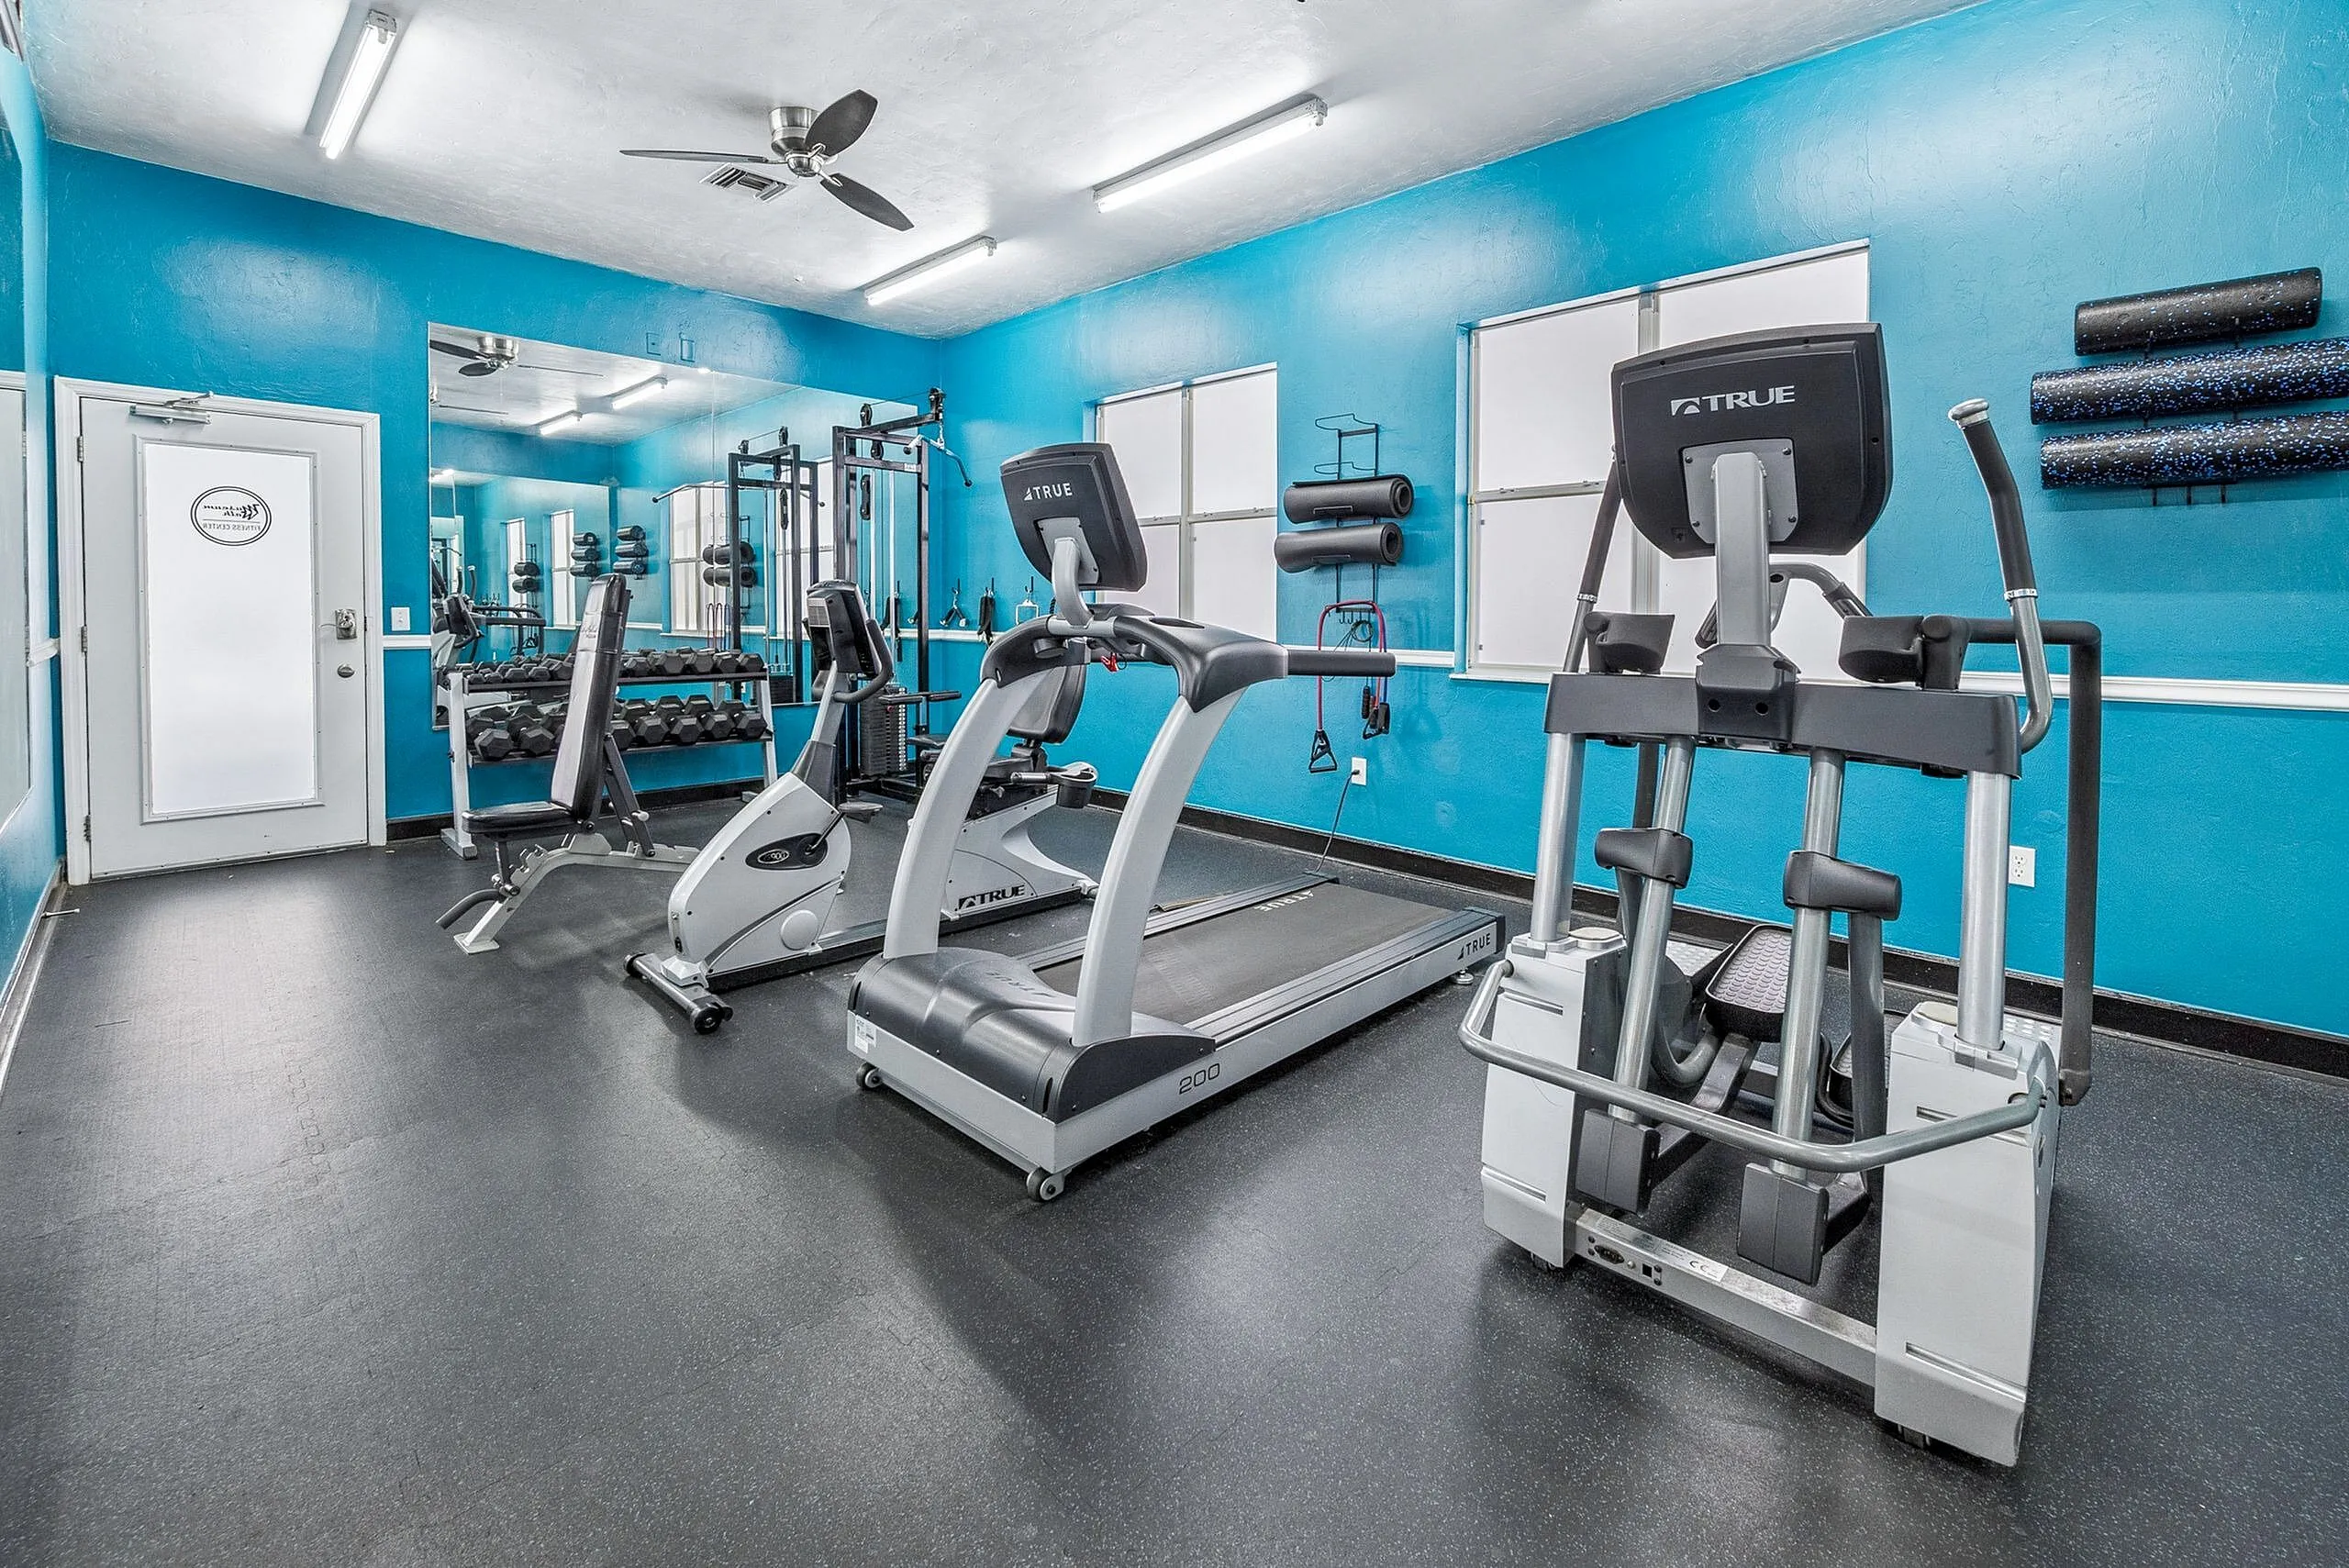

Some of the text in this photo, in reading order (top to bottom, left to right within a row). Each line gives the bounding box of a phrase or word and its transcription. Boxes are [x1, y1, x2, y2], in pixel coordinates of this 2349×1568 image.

[1702, 385, 1796, 412] TRUE
[1032, 483, 1073, 500] TRUE
[975, 884, 1025, 905] TRUE
[1253, 894, 1308, 912] TRUE
[1465, 932, 1491, 956] TRUE
[1179, 1062, 1220, 1095] 200
